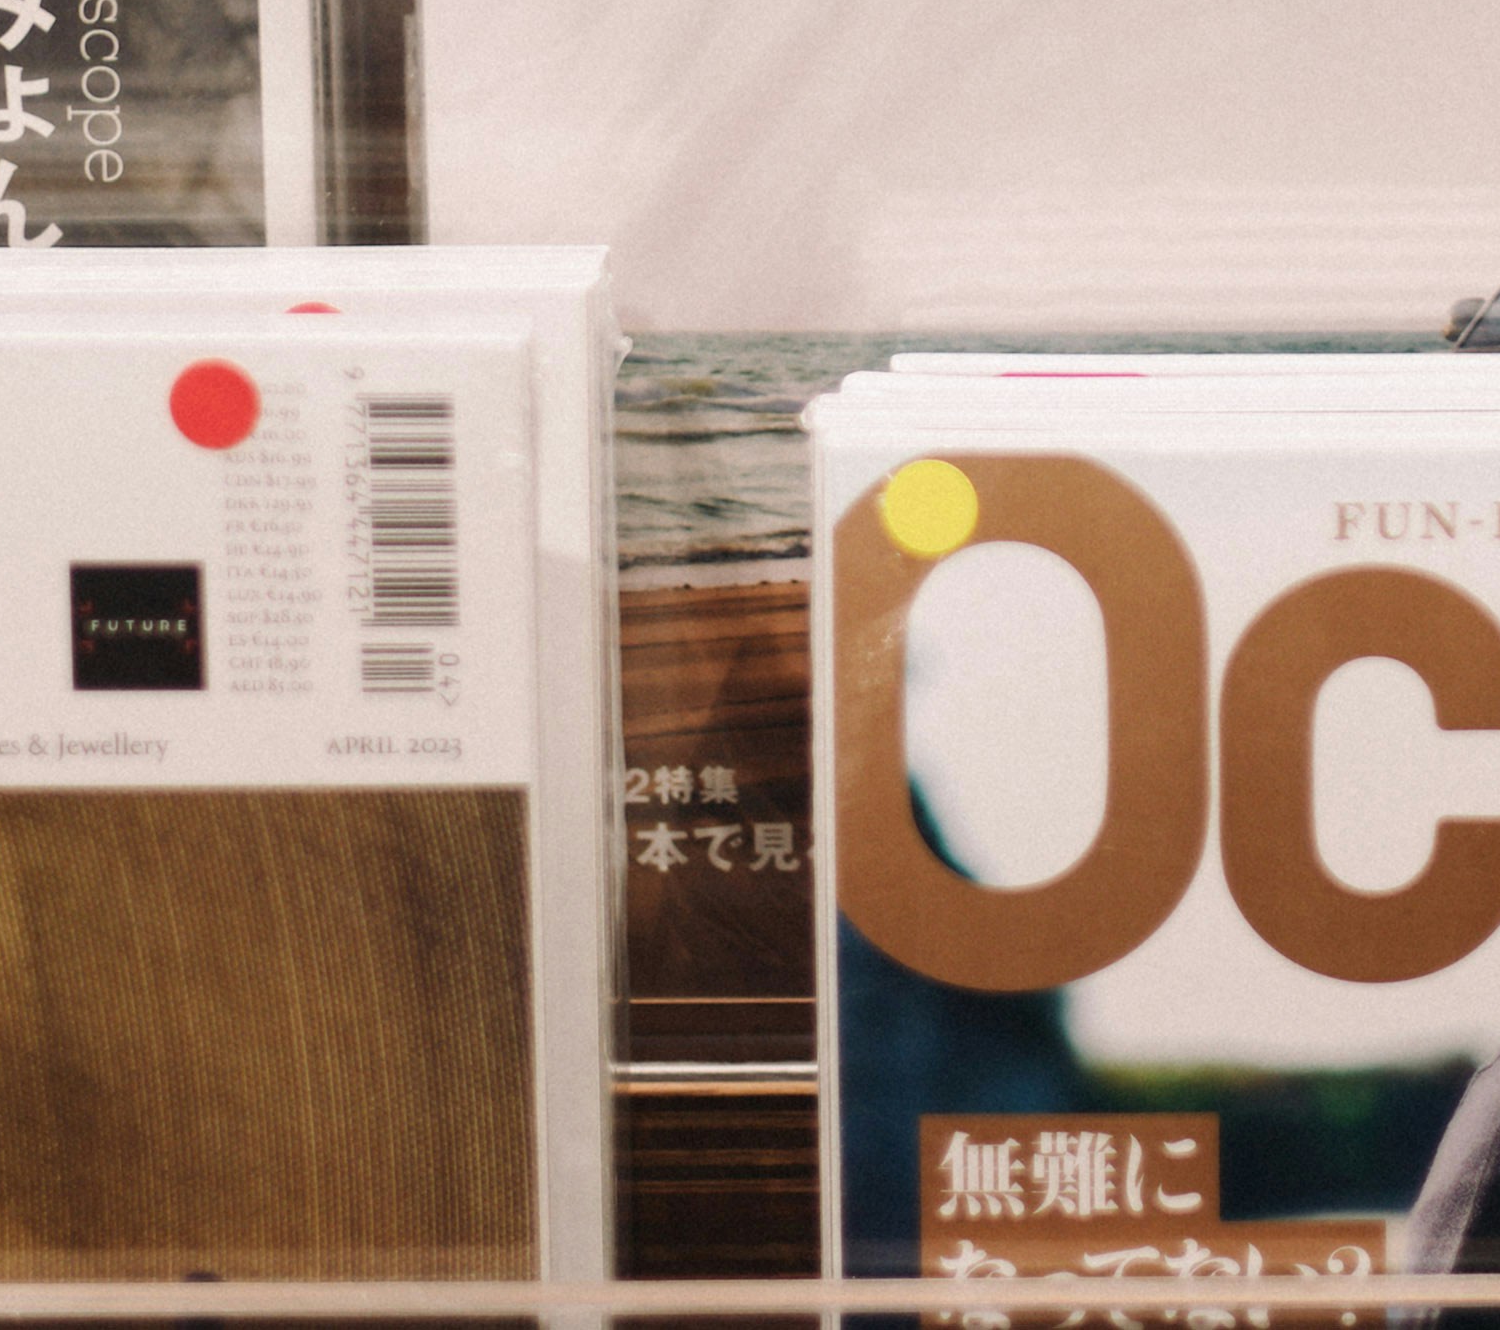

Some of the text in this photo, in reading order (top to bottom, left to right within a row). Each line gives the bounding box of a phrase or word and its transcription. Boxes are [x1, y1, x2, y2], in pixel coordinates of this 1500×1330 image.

[90, 618, 189, 634] FUTURE
[28, 733, 49, 758] &
[55, 731, 169, 763] Jewellery
[326, 737, 401, 758] APRIL
[634, 821, 814, 873] 本で見
[937, 1130, 1204, 1218] 無難に
